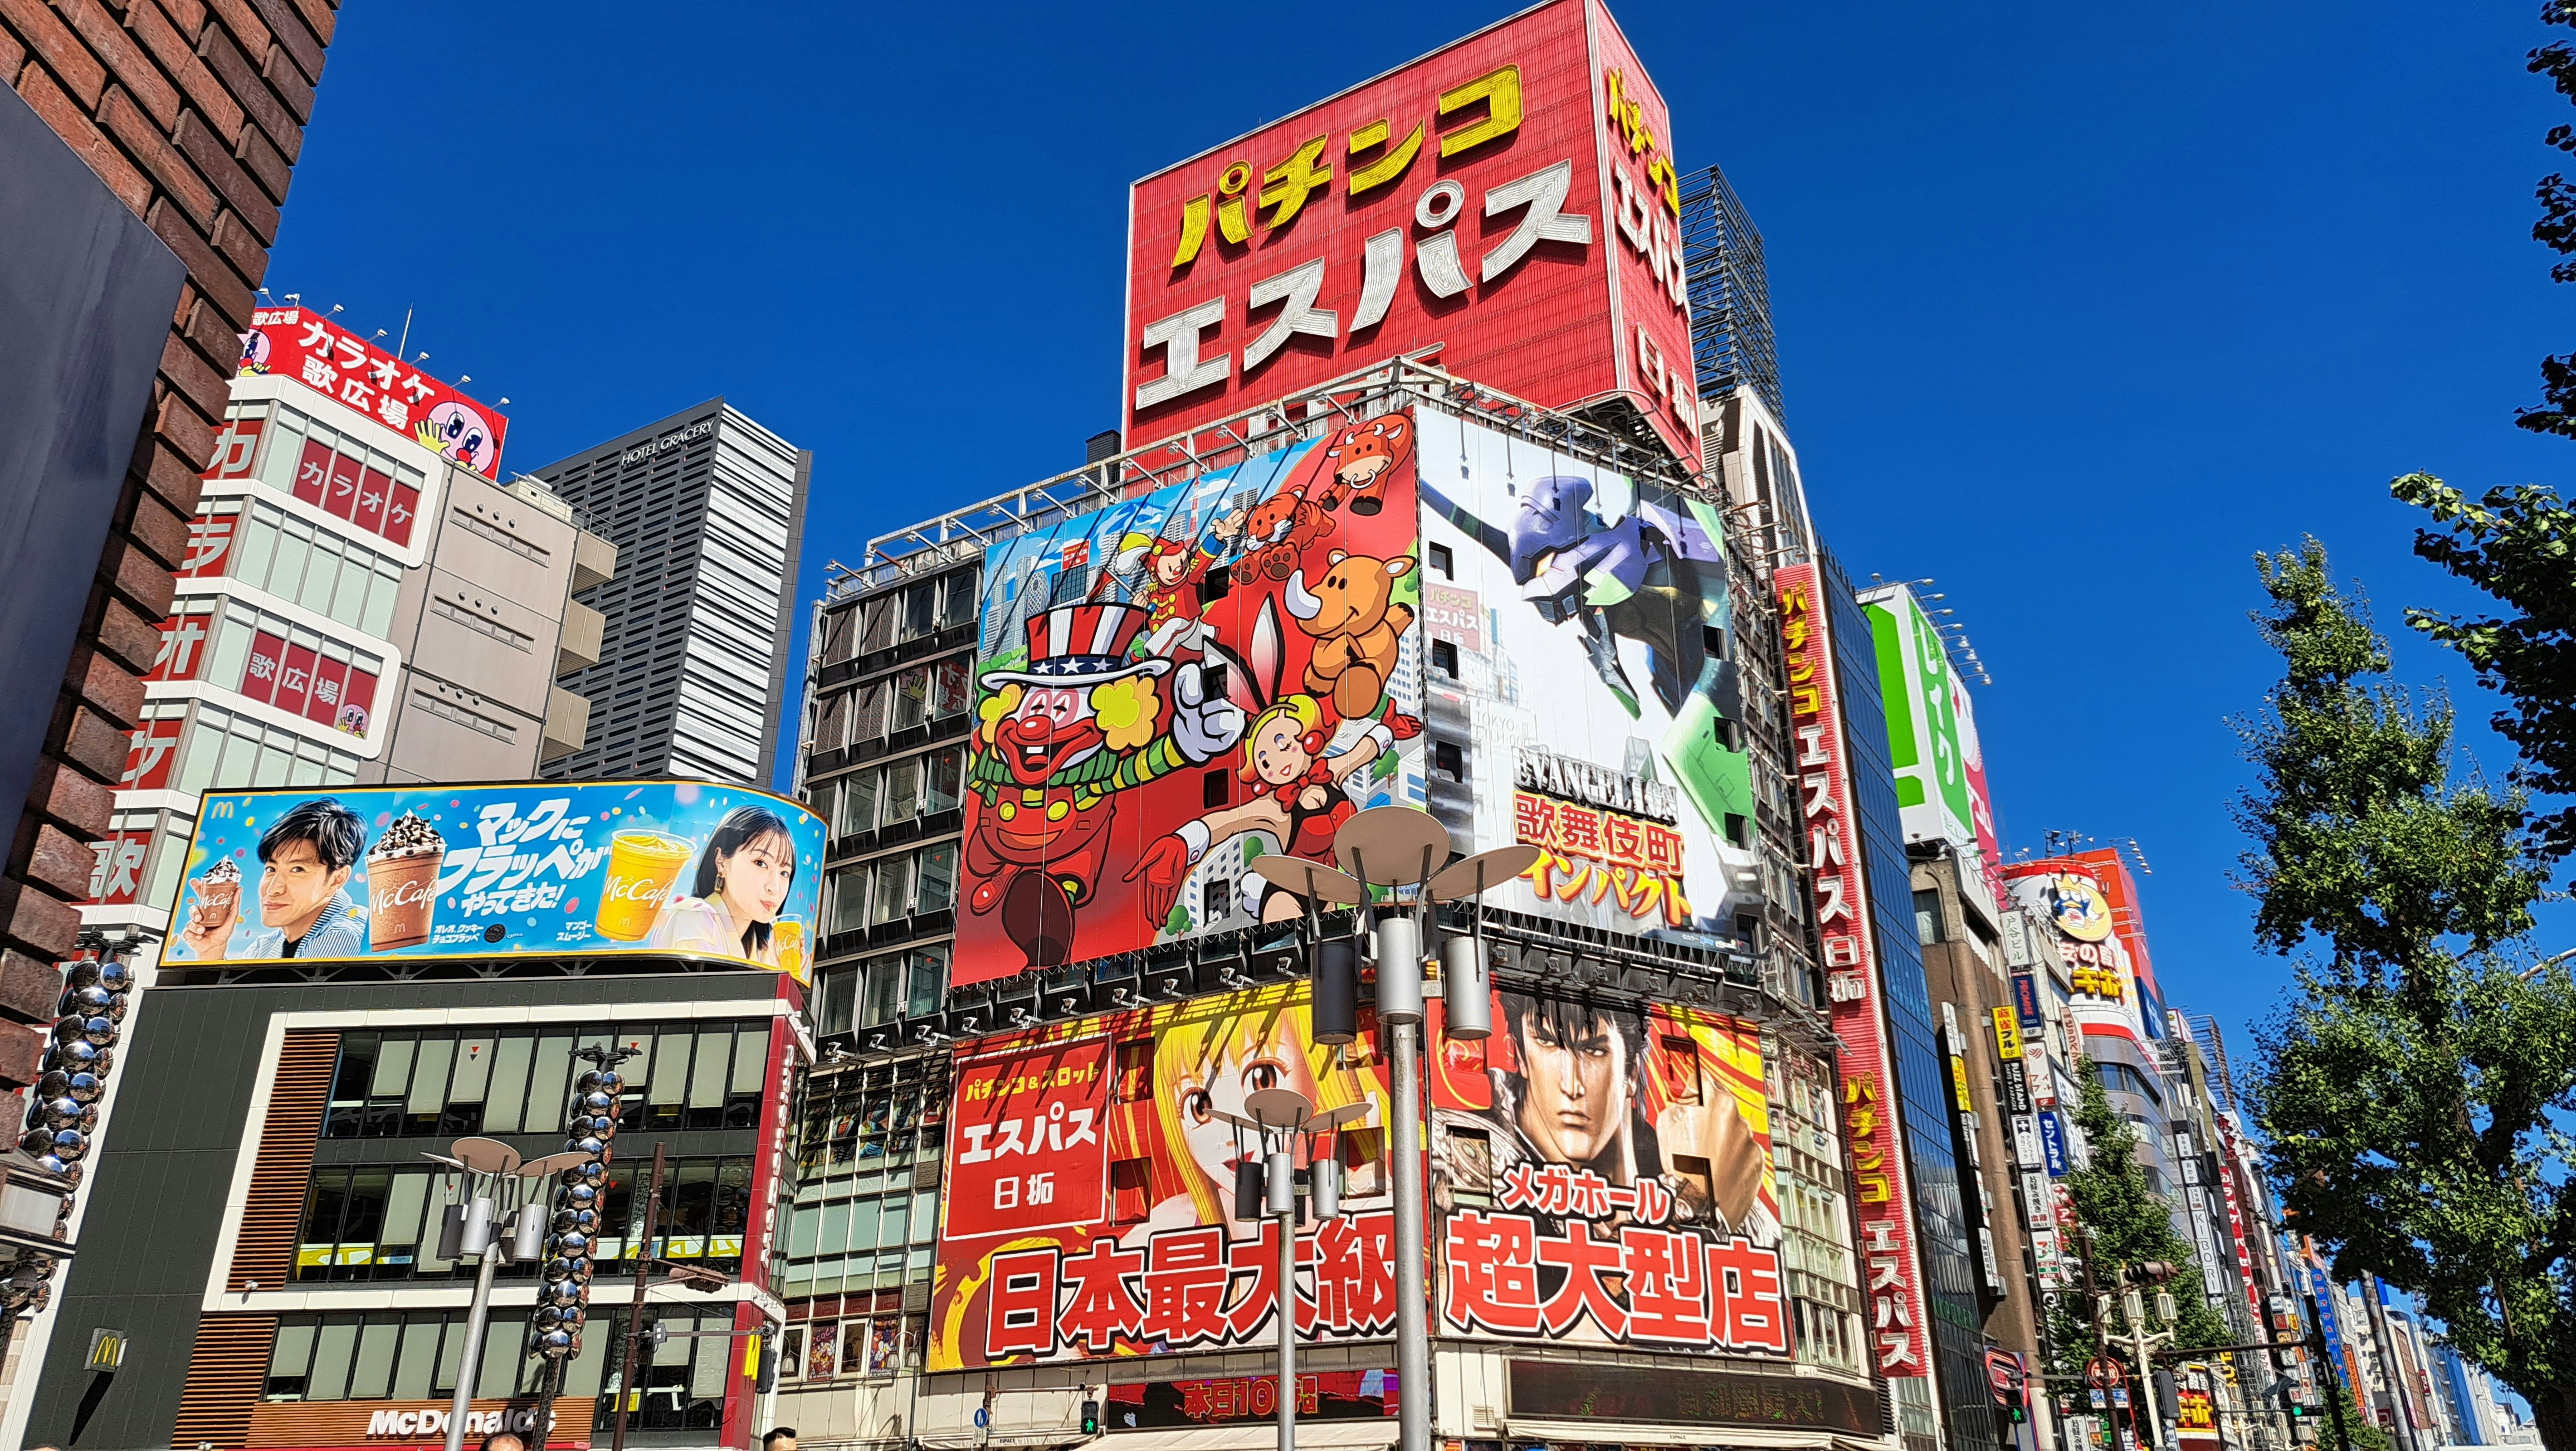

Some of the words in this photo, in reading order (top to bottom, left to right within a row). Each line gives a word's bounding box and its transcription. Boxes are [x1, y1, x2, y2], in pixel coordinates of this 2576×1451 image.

[1172, 63, 1524, 267] パチンコ
[1135, 159, 1592, 411] エスパス
[252, 310, 299, 325] 歌広場
[297, 319, 436, 404] カラオケ
[302, 356, 409, 430] 歌広場
[621, 446, 658, 466] HOTEL
[660, 420, 715, 450] GRACERY
[300, 461, 413, 524] カラオケ
[1426, 607, 1479, 631] エスパス
[1430, 588, 1472, 608] パチンコ
[249, 653, 339, 705] 歌広場
[1782, 581, 1821, 715] パチンコ
[1515, 747, 1678, 822] EVANGELION
[476, 798, 586, 846] マックに
[1514, 793, 1683, 873] 歌舞伎町
[1798, 723, 1855, 924] エスパス
[437, 840, 612, 894] フラッペが
[1519, 848, 1691, 925] インパクト
[432, 933, 480, 944] チョコフラッペ
[556, 931, 591, 942] スムージー
[565, 920, 593, 931] マンゴー
[965, 1060, 1100, 1102] パチンコ&スロット
[2014, 1083, 2027, 1111] STAND
[959, 1101, 1097, 1165] エスパス
[1845, 1070, 1892, 1204] パチンコ
[2042, 1118, 2061, 1169] セントラル
[1503, 1162, 1672, 1225] メガホール
[1445, 1209, 1789, 1352] 超大型店
[1865, 1219, 1918, 1368] エスパス
